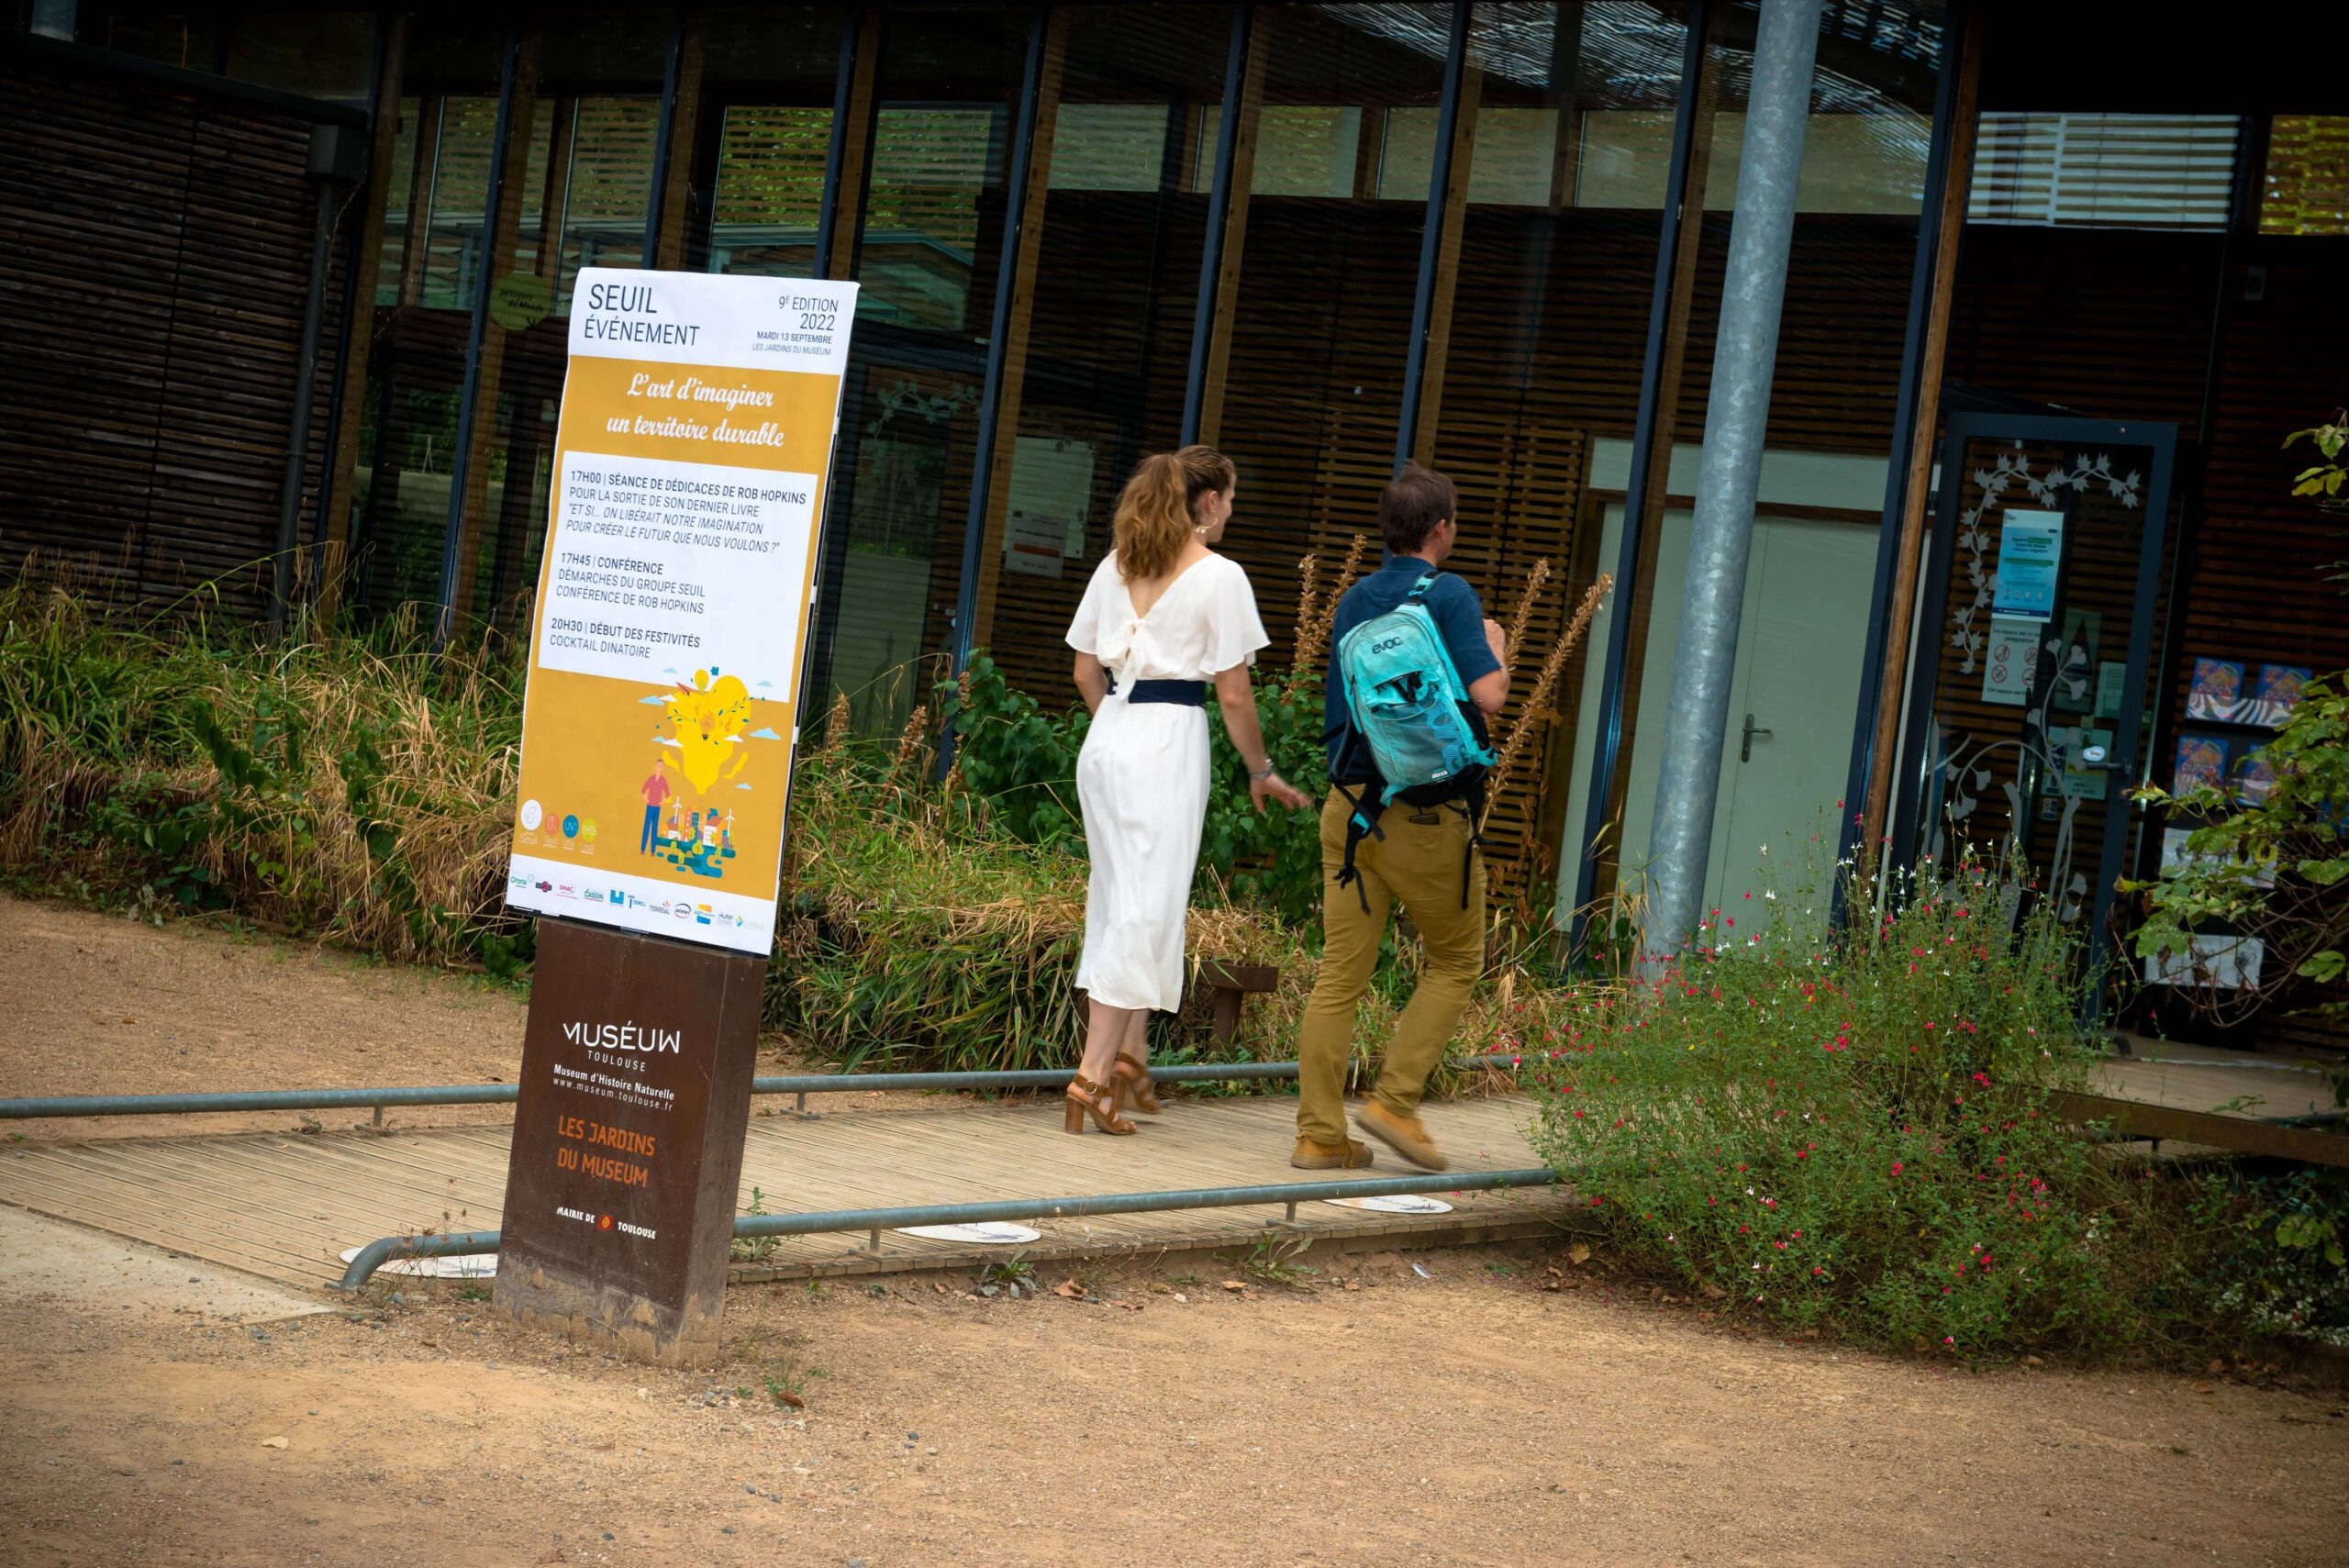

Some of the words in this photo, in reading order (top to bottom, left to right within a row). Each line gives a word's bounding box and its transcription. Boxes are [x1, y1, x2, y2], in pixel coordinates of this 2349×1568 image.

[588, 284, 657, 314] SEUIL
[792, 296, 839, 313] EDITION
[584, 315, 700, 346] ÉVÉNEMENT
[756, 330, 779, 340] MARDI
[781, 332, 789, 341] 13
[790, 333, 832, 344] SEPTEMBRE
[800, 313, 835, 331] 2022
[752, 342, 763, 351] LES
[764, 343, 792, 353] JARDINS
[792, 345, 801, 354] DU
[606, 416, 629, 434] un
[633, 415, 708, 439] territoire
[712, 422, 785, 447] durable
[569, 486, 596, 500] POUR
[597, 489, 610, 502] LA
[612, 491, 647, 506] SORTIE
[649, 495, 662, 507] DE
[663, 496, 685, 510] SON
[686, 498, 729, 514] DERNIER
[730, 504, 760, 517] LIVRE
[571, 471, 601, 484] 17H00
[608, 473, 649, 488] SÉANCE
[650, 478, 663, 490] DE
[664, 478, 721, 496] DÉDICACES
[722, 485, 736, 498] DE
[738, 486, 759, 500] ROB
[760, 489, 807, 505] HOPKINS
[565, 519, 593, 533] POUR
[593, 522, 624, 537] CRÉER
[624, 526, 639, 539] LE
[638, 528, 671, 541] FUTUR
[673, 531, 693, 545] QUE
[693, 533, 722, 548] NOUS
[723, 538, 770, 553] VOULONS
[603, 506, 618, 519] ON
[618, 508, 662, 524] LIBÉRAIT
[662, 514, 697, 528] NOTRE
[697, 517, 763, 535] IMAGINATION
[561, 552, 591, 566] 17H45
[597, 556, 664, 575] CONFÉRENCE
[558, 568, 618, 586] DÉMARCHES
[619, 575, 635, 588] DU
[636, 578, 677, 594] GROUPE
[677, 583, 706, 597] SEUIL
[556, 584, 621, 604] CONFÉRENCE
[622, 593, 636, 606] DE
[638, 595, 659, 608] ROB
[660, 598, 705, 615] HOPKINS
[550, 634, 598, 651] COCKTAIL
[600, 640, 651, 659] DINATOIRE
[551, 617, 583, 632] 20H30
[589, 622, 623, 638] DÉBUT
[624, 628, 644, 640] DES
[644, 629, 701, 648] FESTIVITÉS
[587, 1050, 646, 1072] TOULOUSE
[552, 1077, 673, 1111] www.museum.toulouse.fr
[554, 1064, 588, 1080] Museum
[590, 1073, 631, 1090] d'Histoire
[634, 1083, 674, 1100] Naturelle
[557, 1115, 584, 1140] LES
[587, 1122, 656, 1157] JARDINS
[557, 1148, 578, 1170] DU
[582, 1153, 649, 1188] MUSEUM
[556, 1207, 584, 1220] MAIRIE
[585, 1213, 596, 1223] DE
[618, 1221, 657, 1239] TOULOUSE
